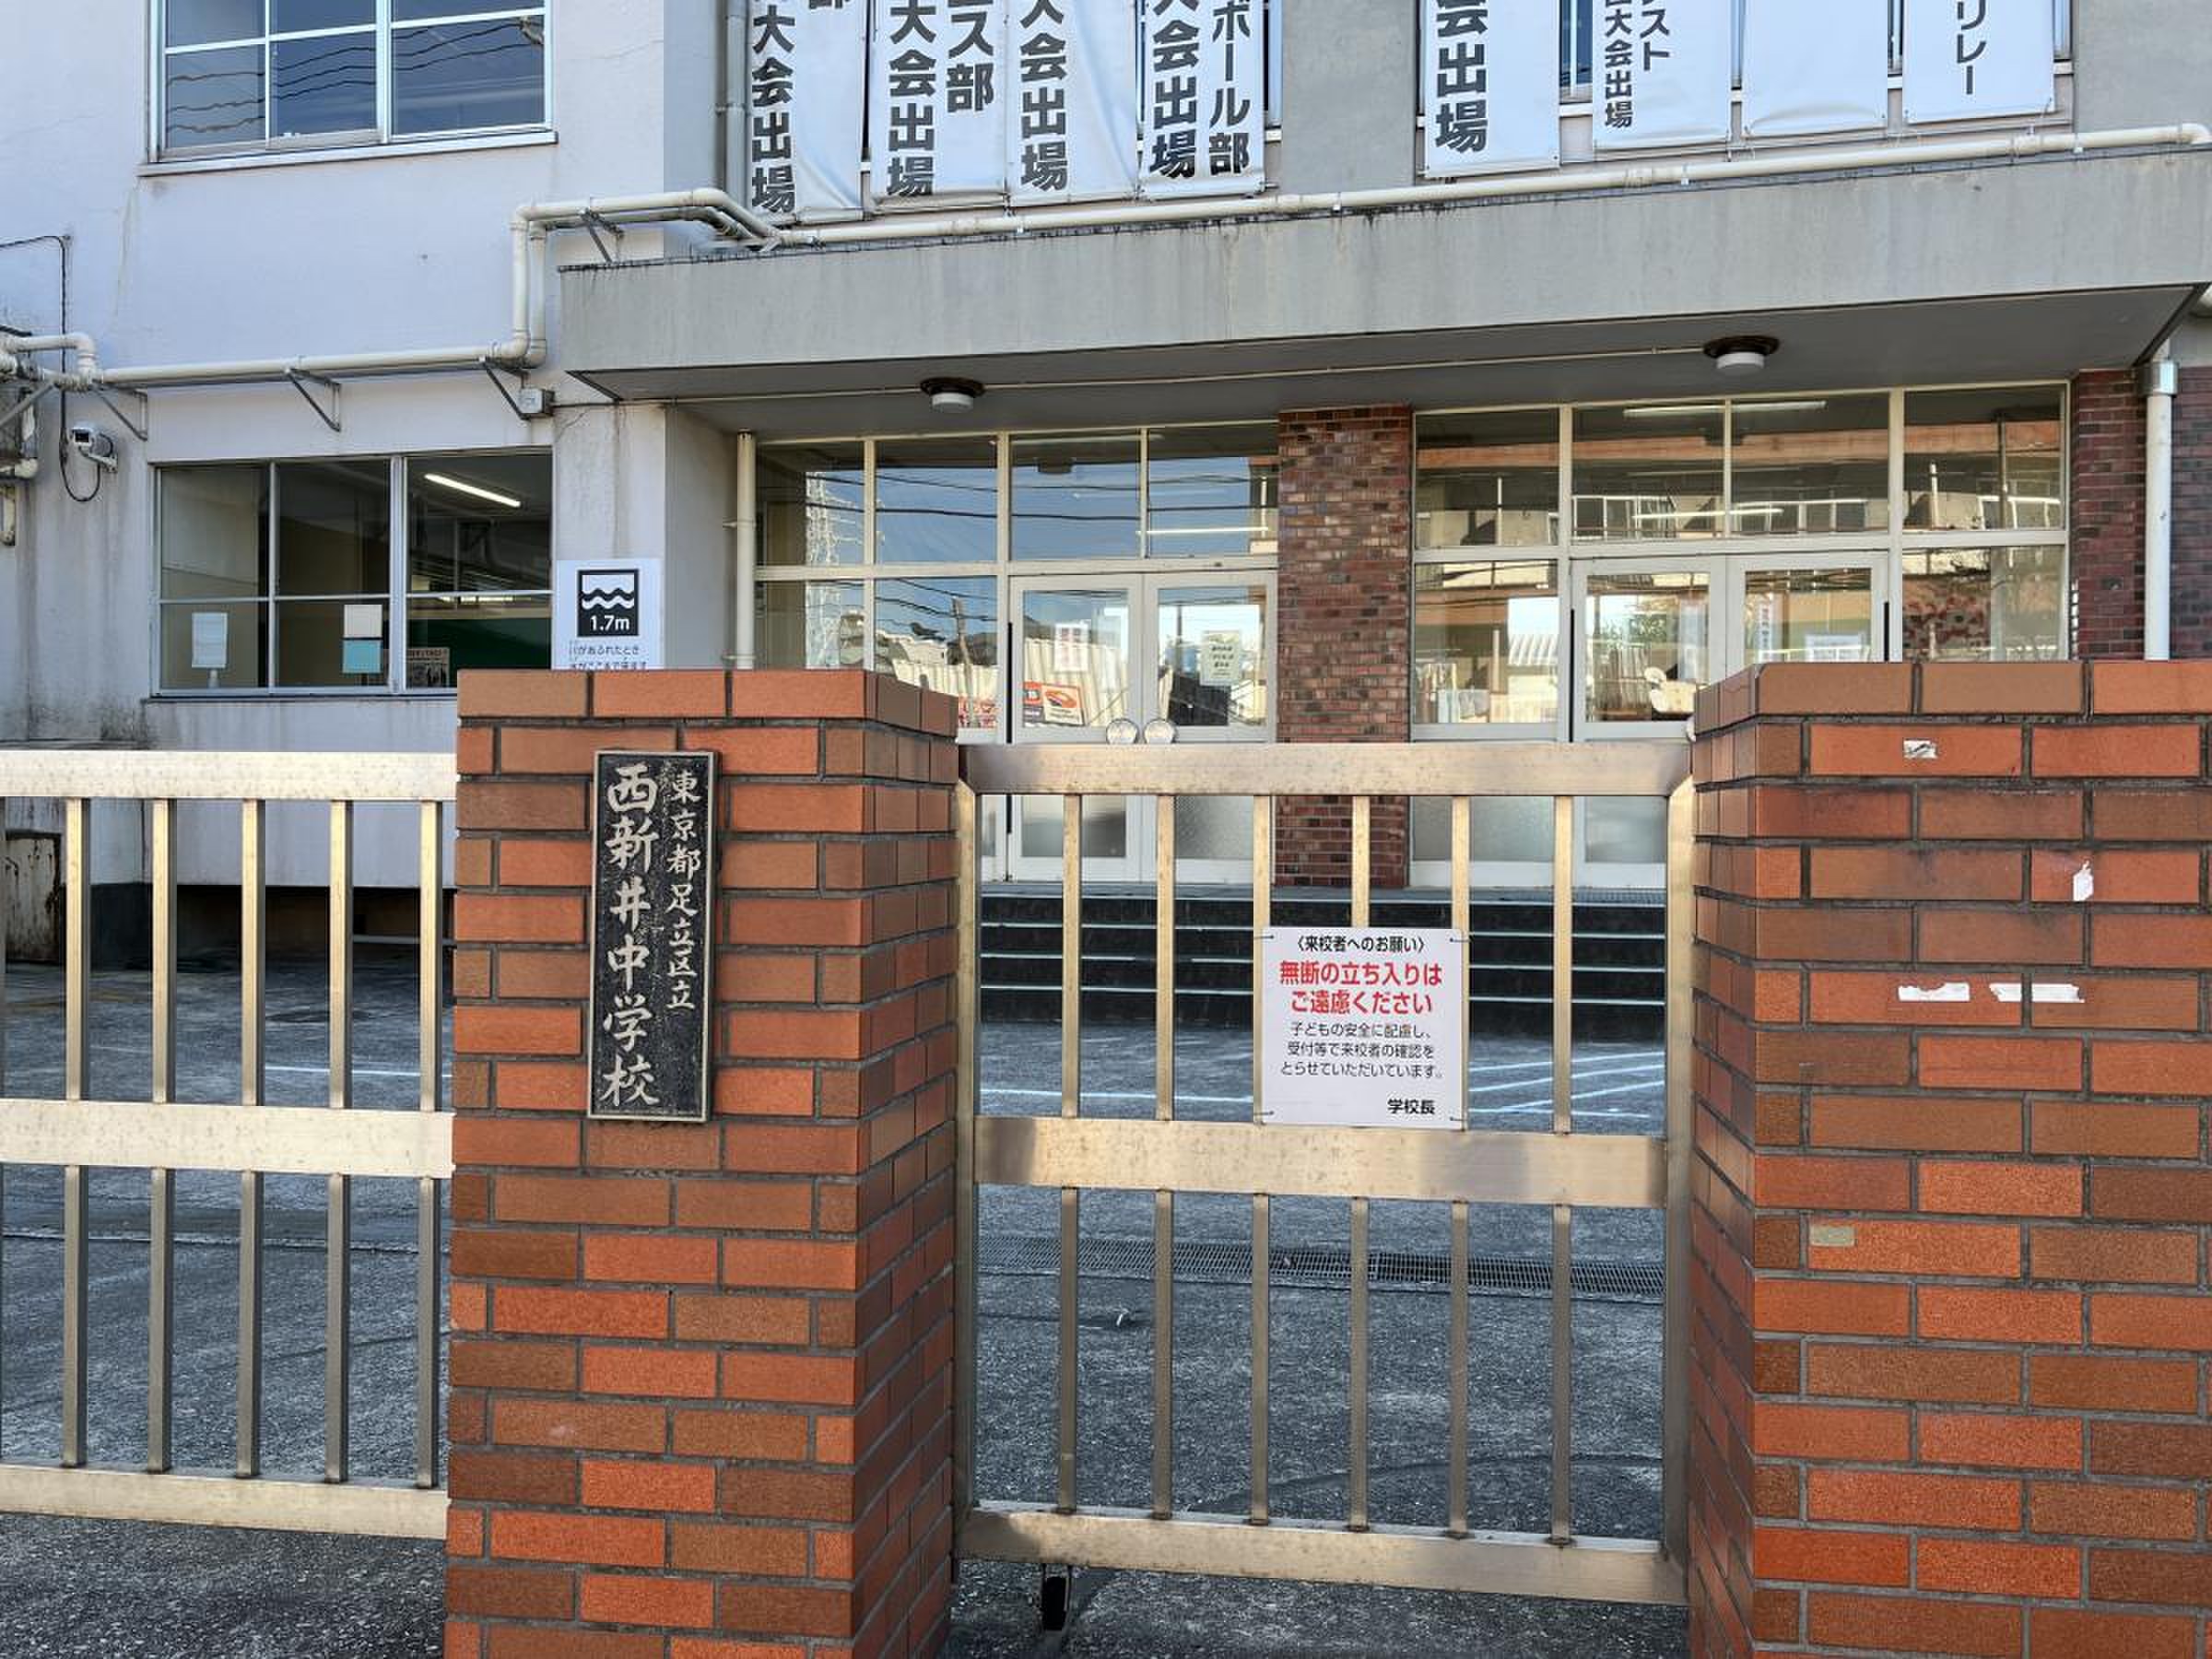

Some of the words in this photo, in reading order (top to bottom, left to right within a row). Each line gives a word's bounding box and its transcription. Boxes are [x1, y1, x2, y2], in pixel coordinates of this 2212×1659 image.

[1640, 0, 1669, 71] スト
[1605, 0, 1633, 128] 大会出場
[887, 0, 936, 196] 大会出場
[590, 615, 629, 630] 1.7m
[665, 770, 702, 1010] 東京都足立区立
[599, 761, 660, 1107] 西新井中学校
[1279, 959, 1442, 986] 無断の立ち入りは
[1291, 990, 1432, 1015] ご遠慮ください
[1290, 1022, 1430, 1039] 子どもの安全に配慮し、
[1288, 1042, 1434, 1059] 受付等で来校者の確認を
[1281, 1062, 1443, 1078] とらせていただいています。
[1387, 1100, 1436, 1115] 学校長
